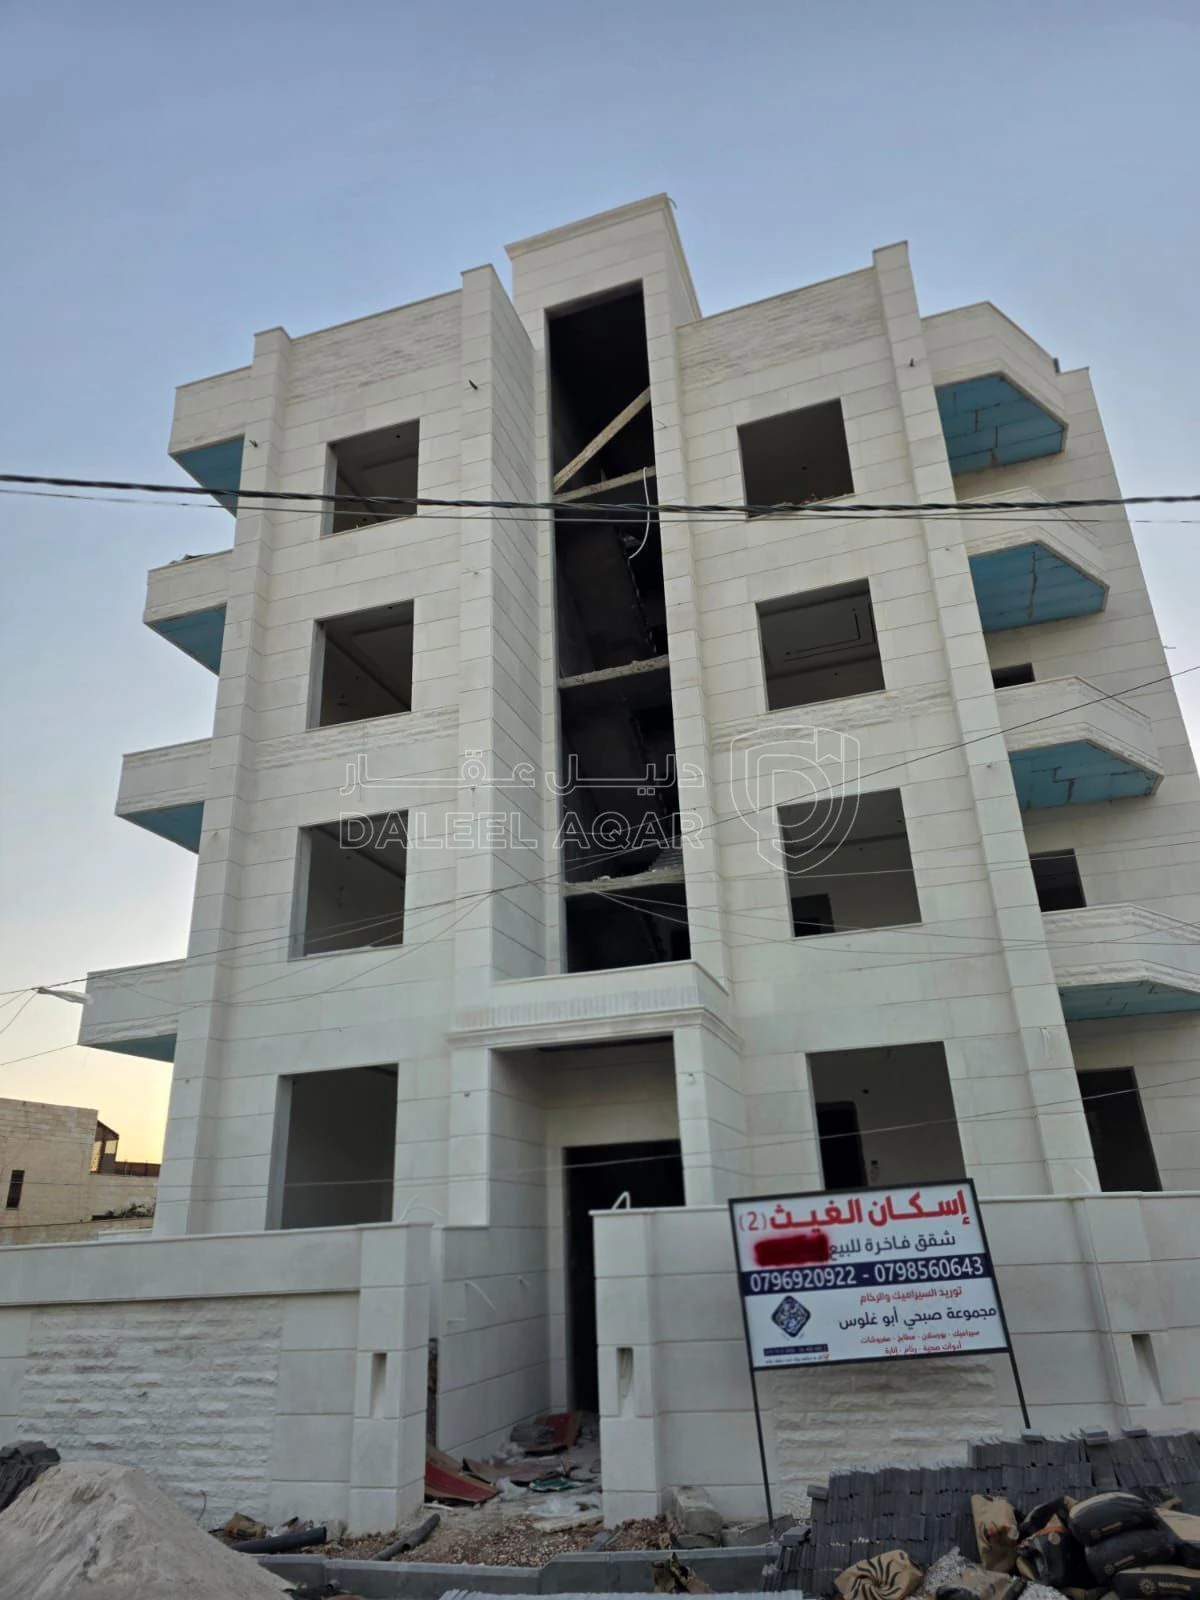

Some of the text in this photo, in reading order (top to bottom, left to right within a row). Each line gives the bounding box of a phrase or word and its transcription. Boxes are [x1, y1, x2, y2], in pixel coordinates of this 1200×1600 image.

[770, 1198, 863, 1235] الغيث
[868, 1189, 971, 1227] إسكان
[829, 1230, 956, 1261] شقق فاخرة للبيع
[750, 1266, 857, 1292] 0796920922
[874, 1256, 984, 1283] 0798560643
[882, 1306, 899, 1327] أبو
[903, 1311, 943, 1330] صبحي
[947, 1306, 997, 1321] مجموعة
